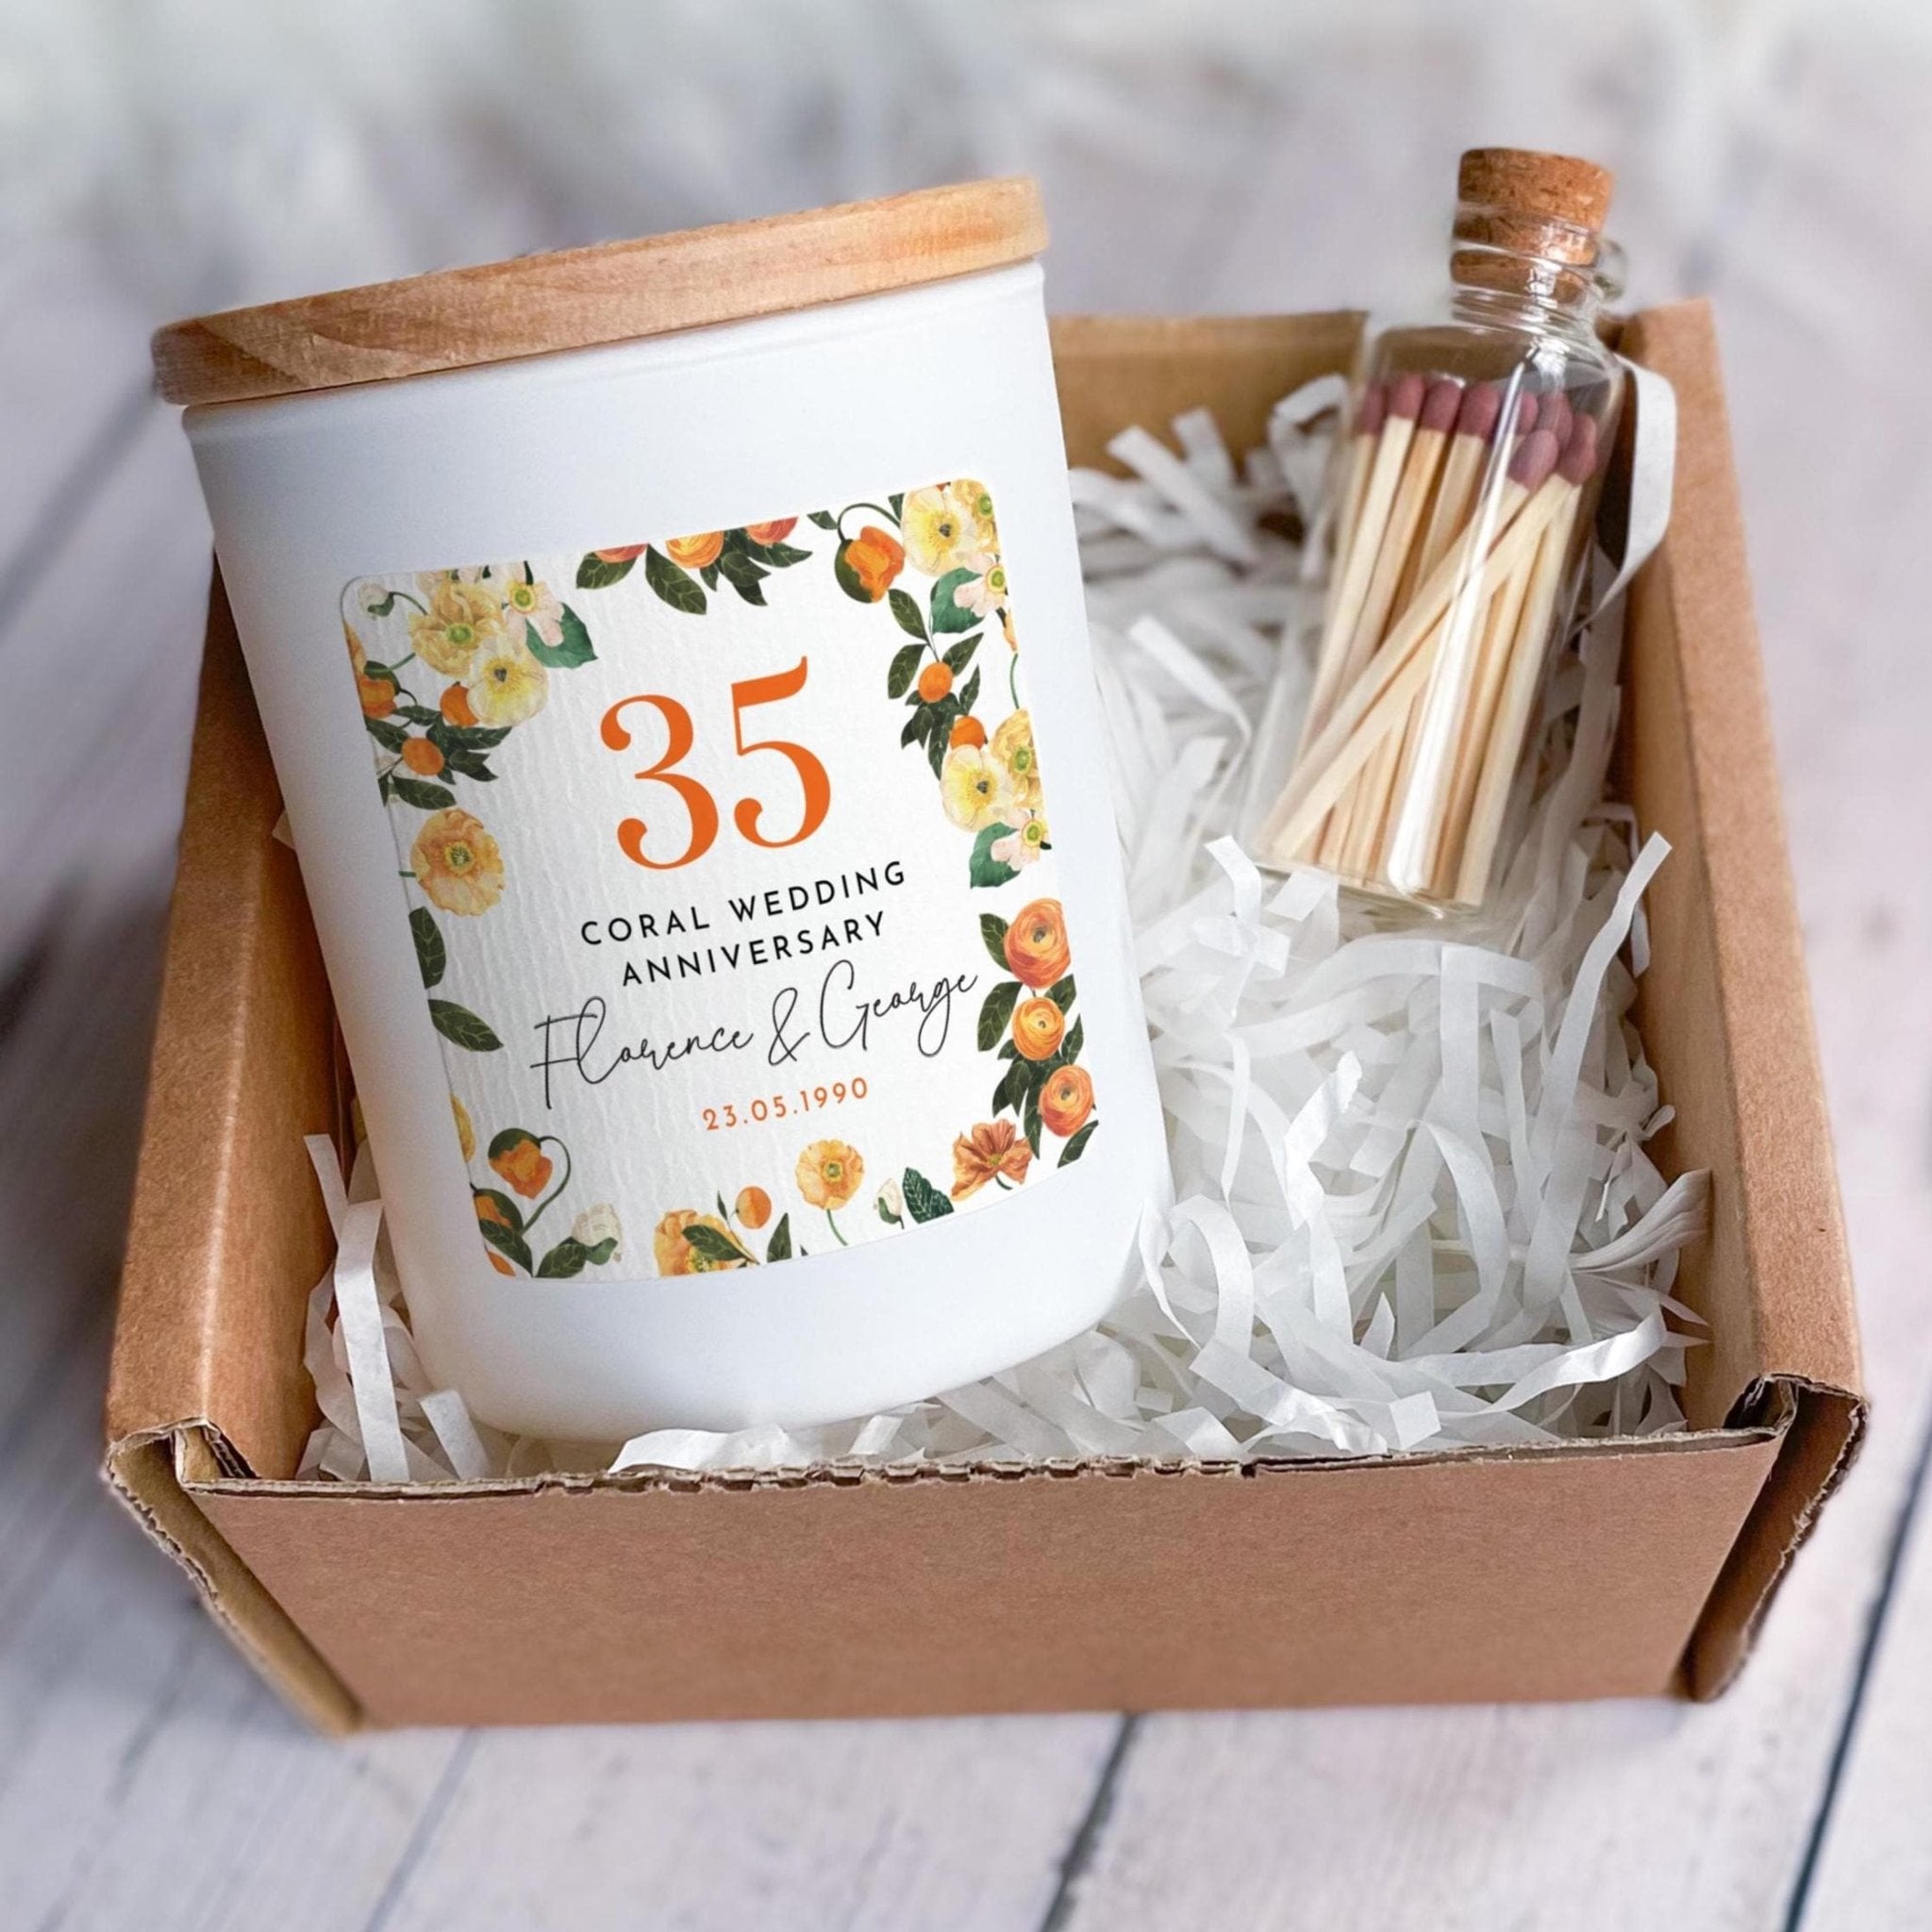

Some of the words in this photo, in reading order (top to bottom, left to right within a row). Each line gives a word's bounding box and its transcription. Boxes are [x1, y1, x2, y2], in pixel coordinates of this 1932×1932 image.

[600, 655, 833, 872] 35
[580, 906, 710, 946] CORAL
[728, 860, 907, 922] WEDDING
[622, 910, 887, 987] ANNIVERSARY
[529, 995, 754, 1110] Florence
[767, 987, 811, 1066] &
[819, 958, 979, 1058] George
[701, 1076, 870, 1132] 23.05.1990
